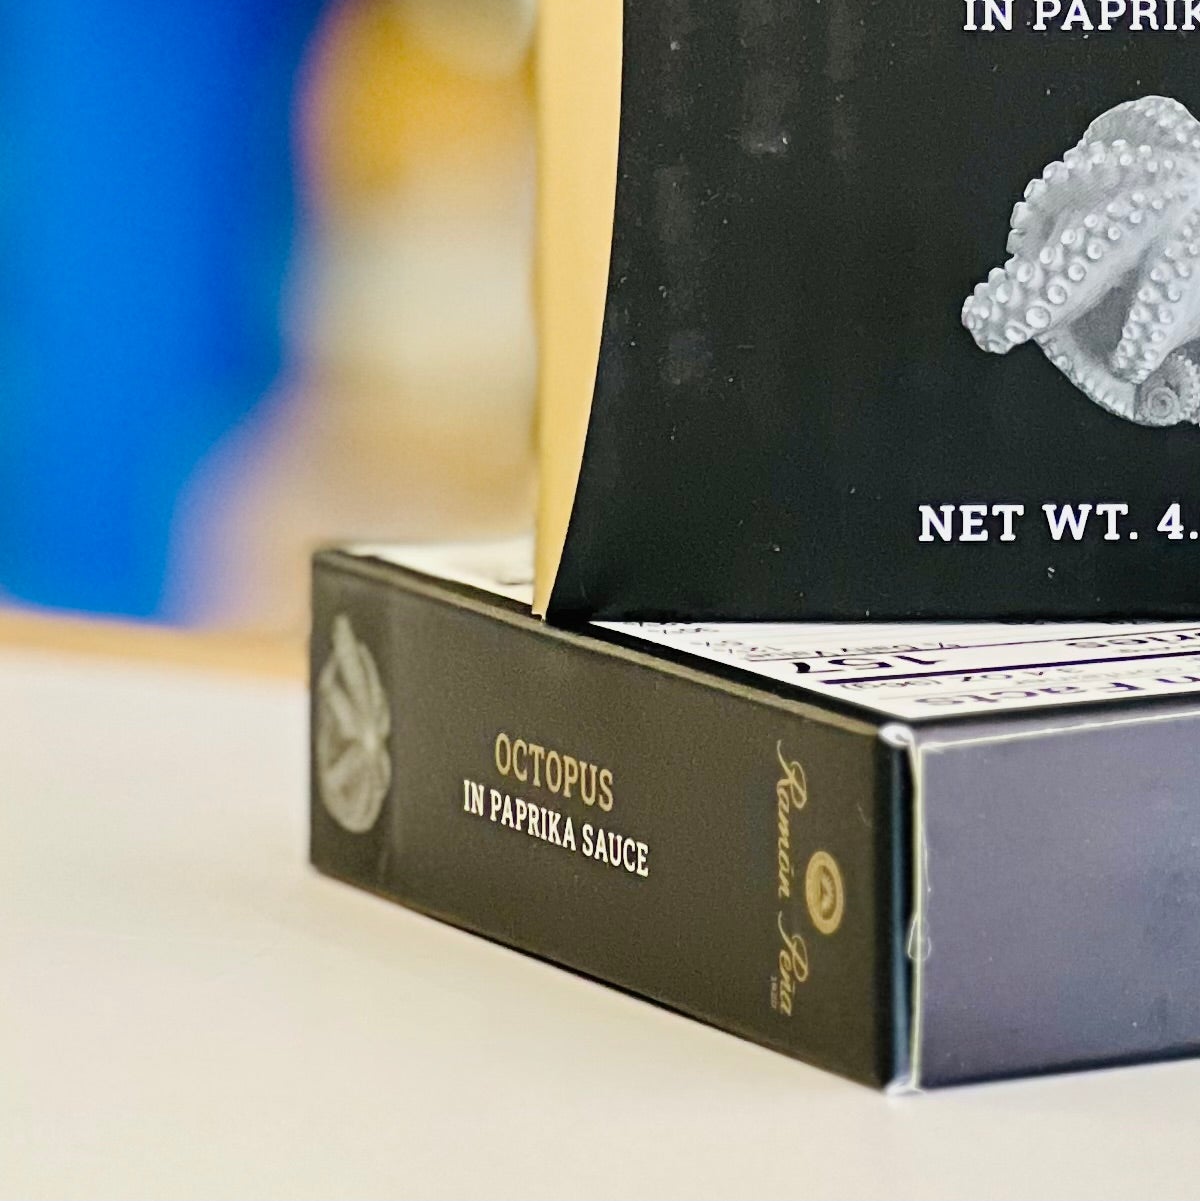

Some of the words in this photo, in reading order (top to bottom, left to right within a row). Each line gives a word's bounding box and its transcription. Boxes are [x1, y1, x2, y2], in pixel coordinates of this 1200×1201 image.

[918, 503, 1024, 542] NET
[1042, 503, 1139, 542] WT.
[494, 732, 614, 812] OCTOPUS
[463, 779, 485, 816] IN
[489, 789, 577, 851] PAPRIKA
[581, 822, 649, 878] SAUCE
[776, 739, 807, 898] Ramón
